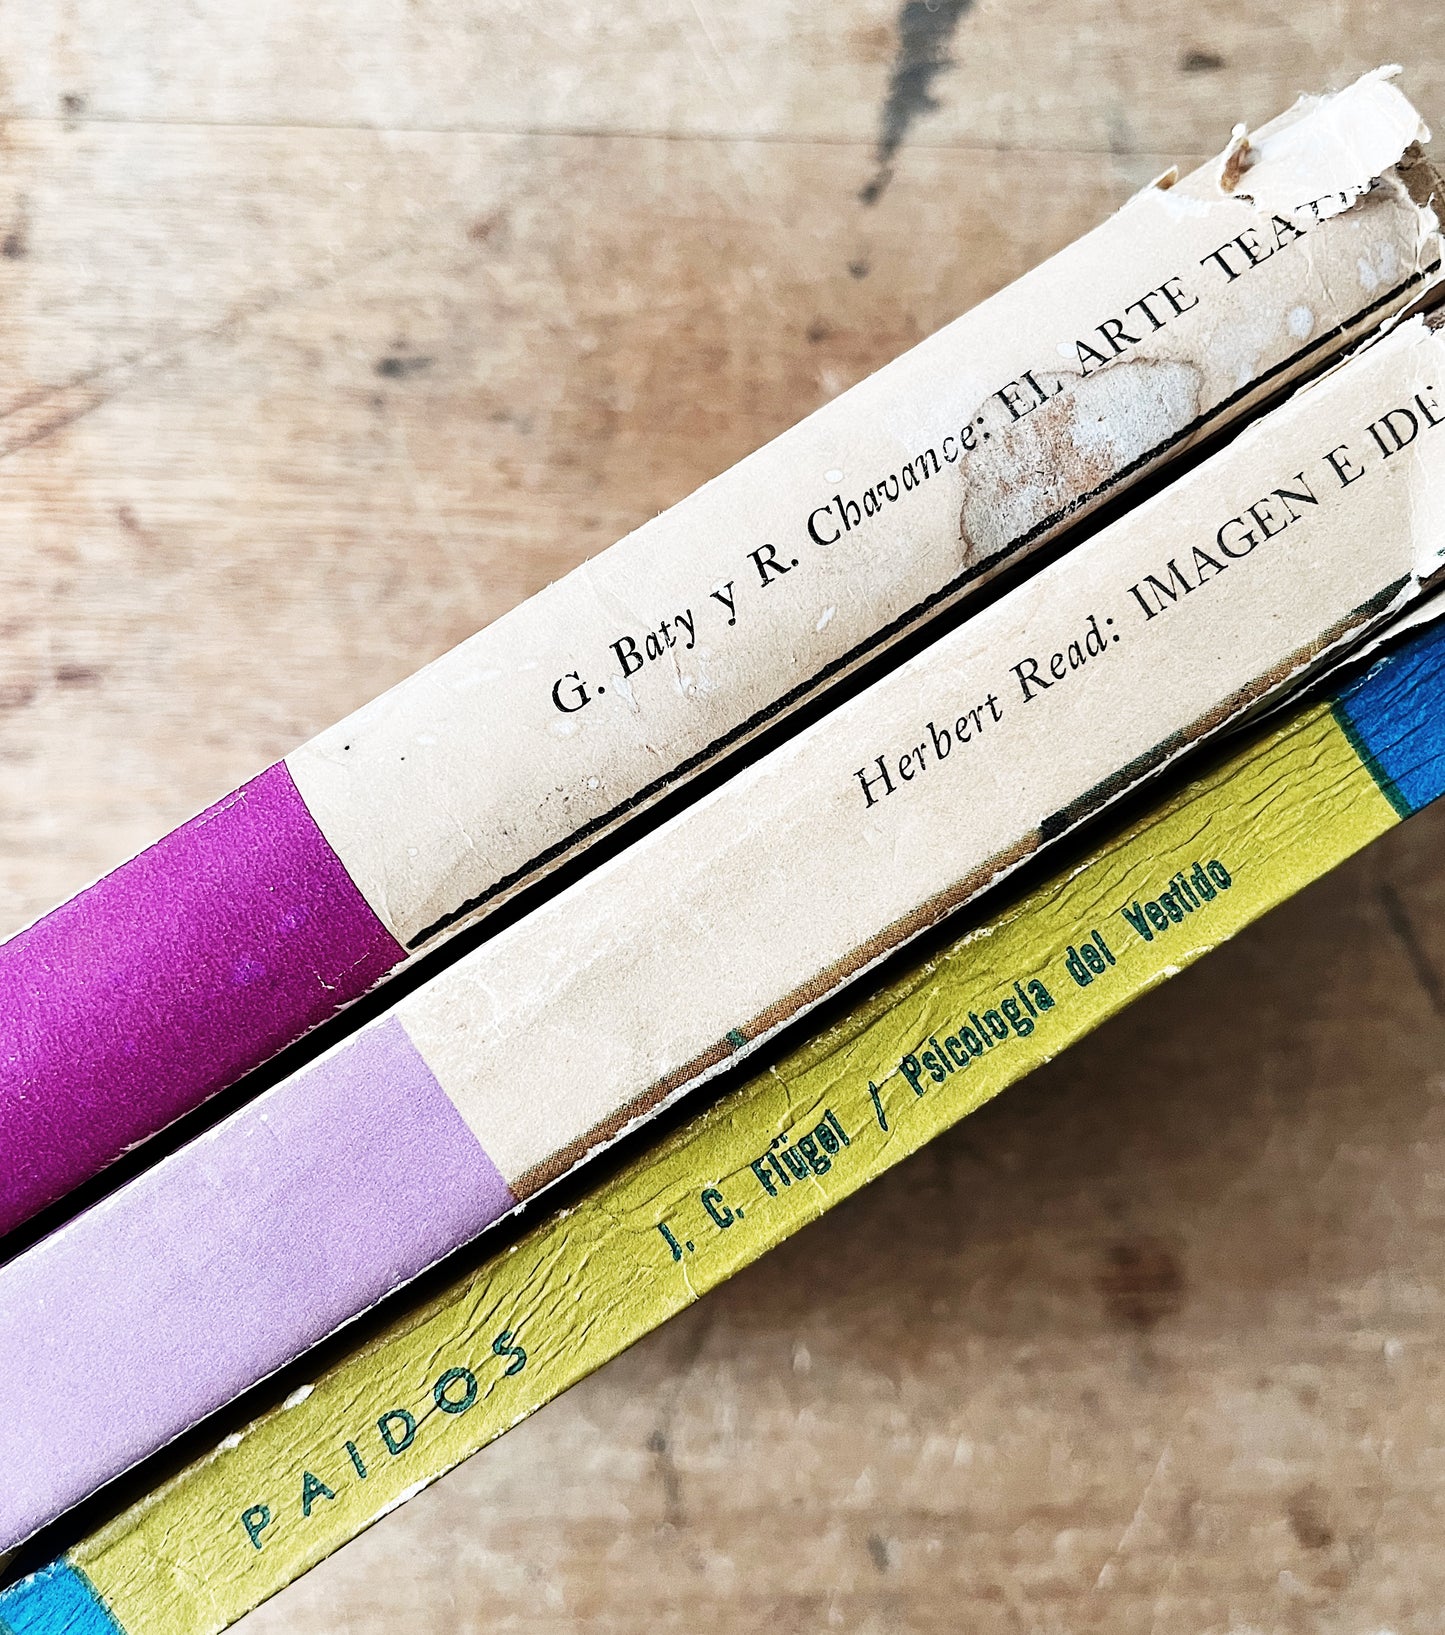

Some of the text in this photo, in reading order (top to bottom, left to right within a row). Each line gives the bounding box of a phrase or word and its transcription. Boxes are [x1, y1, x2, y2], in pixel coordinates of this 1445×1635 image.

[551, 670, 606, 714] G.
[608, 608, 696, 679] Baty
[709, 580, 737, 627] y
[746, 543, 800, 589] R.
[807, 415, 991, 547] Chavance:
[992, 366, 1065, 423] EL
[1071, 276, 1200, 377] ARTE
[853, 693, 1003, 809] Herbert
[1008, 614, 1121, 704] Read:
[1126, 472, 1320, 622] IMAGEN
[1321, 444, 1366, 489] E
[700, 1187, 745, 1229] C.
[1065, 929, 1116, 987] del
[241, 1330, 527, 1550] PAIDOS
